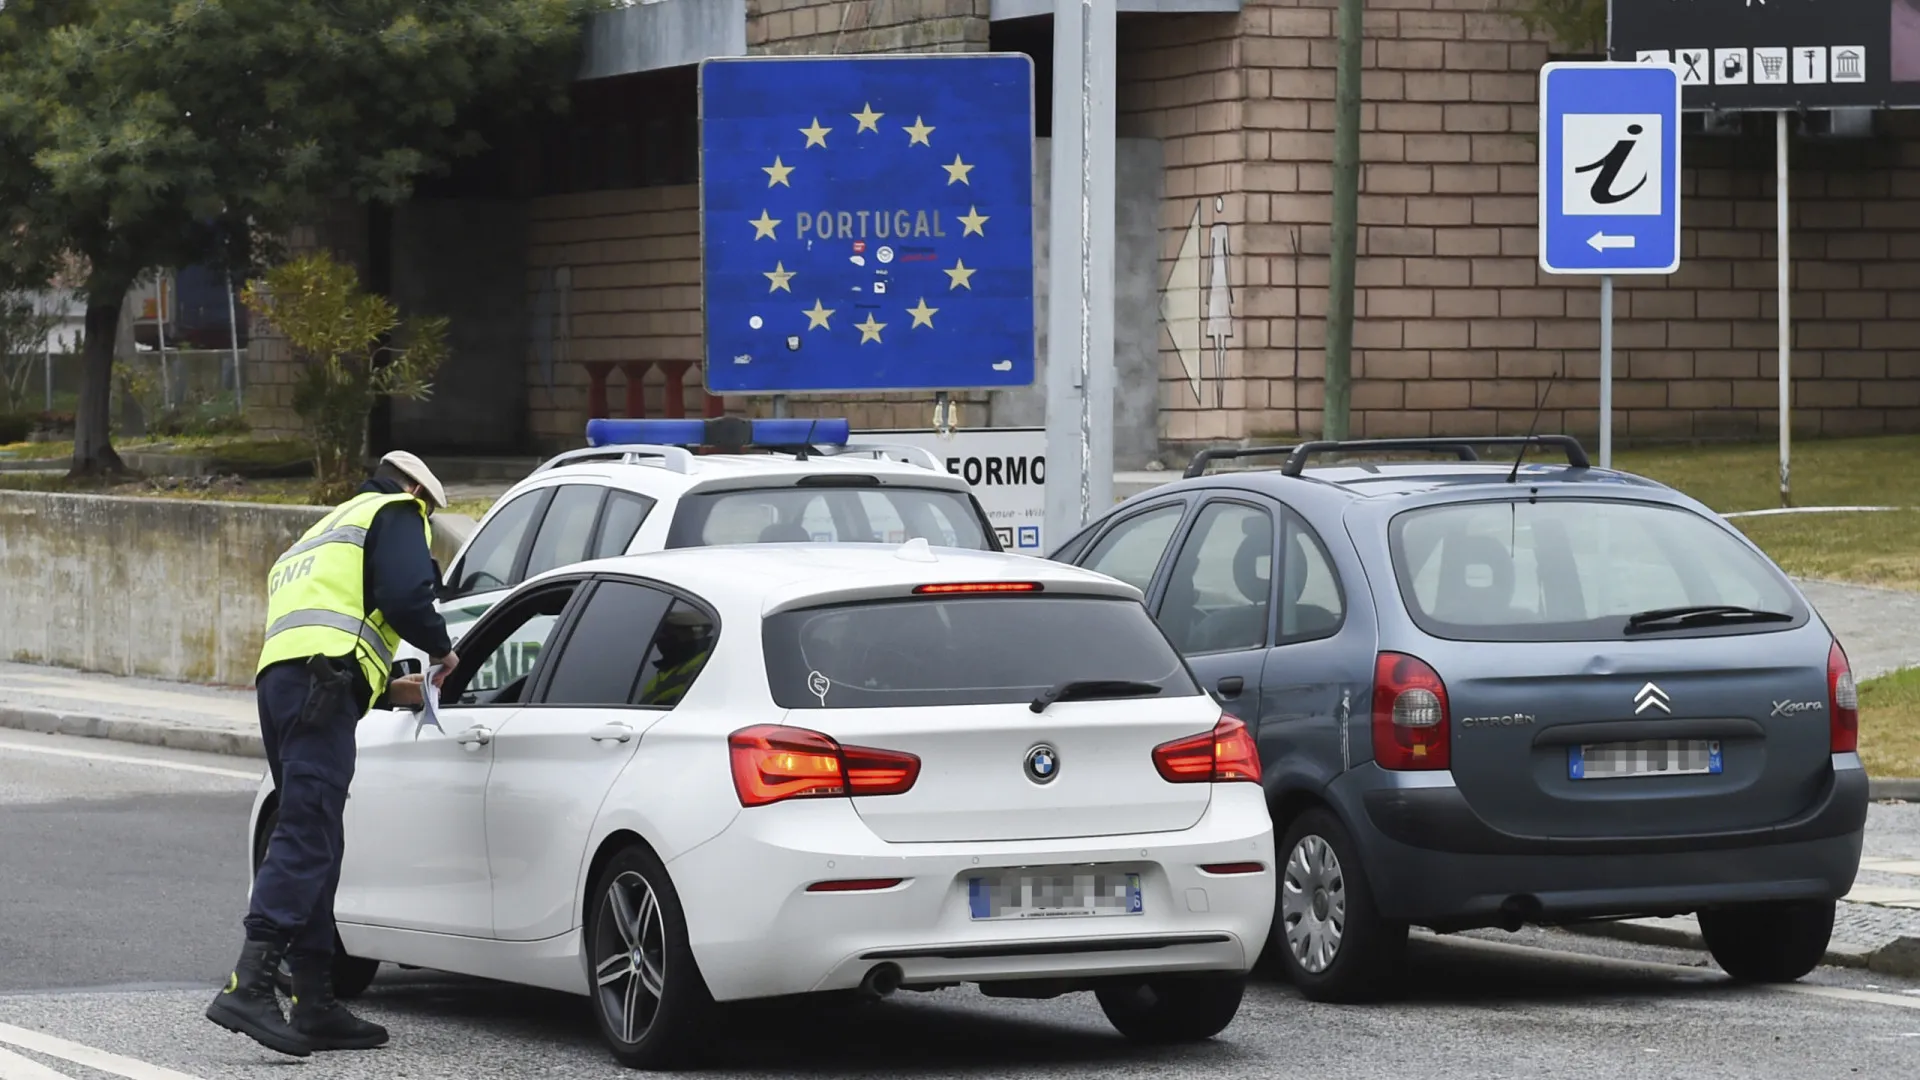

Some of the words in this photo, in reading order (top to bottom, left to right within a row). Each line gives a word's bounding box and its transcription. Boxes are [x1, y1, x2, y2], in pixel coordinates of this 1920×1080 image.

[796, 209, 946, 239] PORTUGAL
[270, 555, 316, 596] GNR
[1461, 713, 1536, 727] CITROËN
